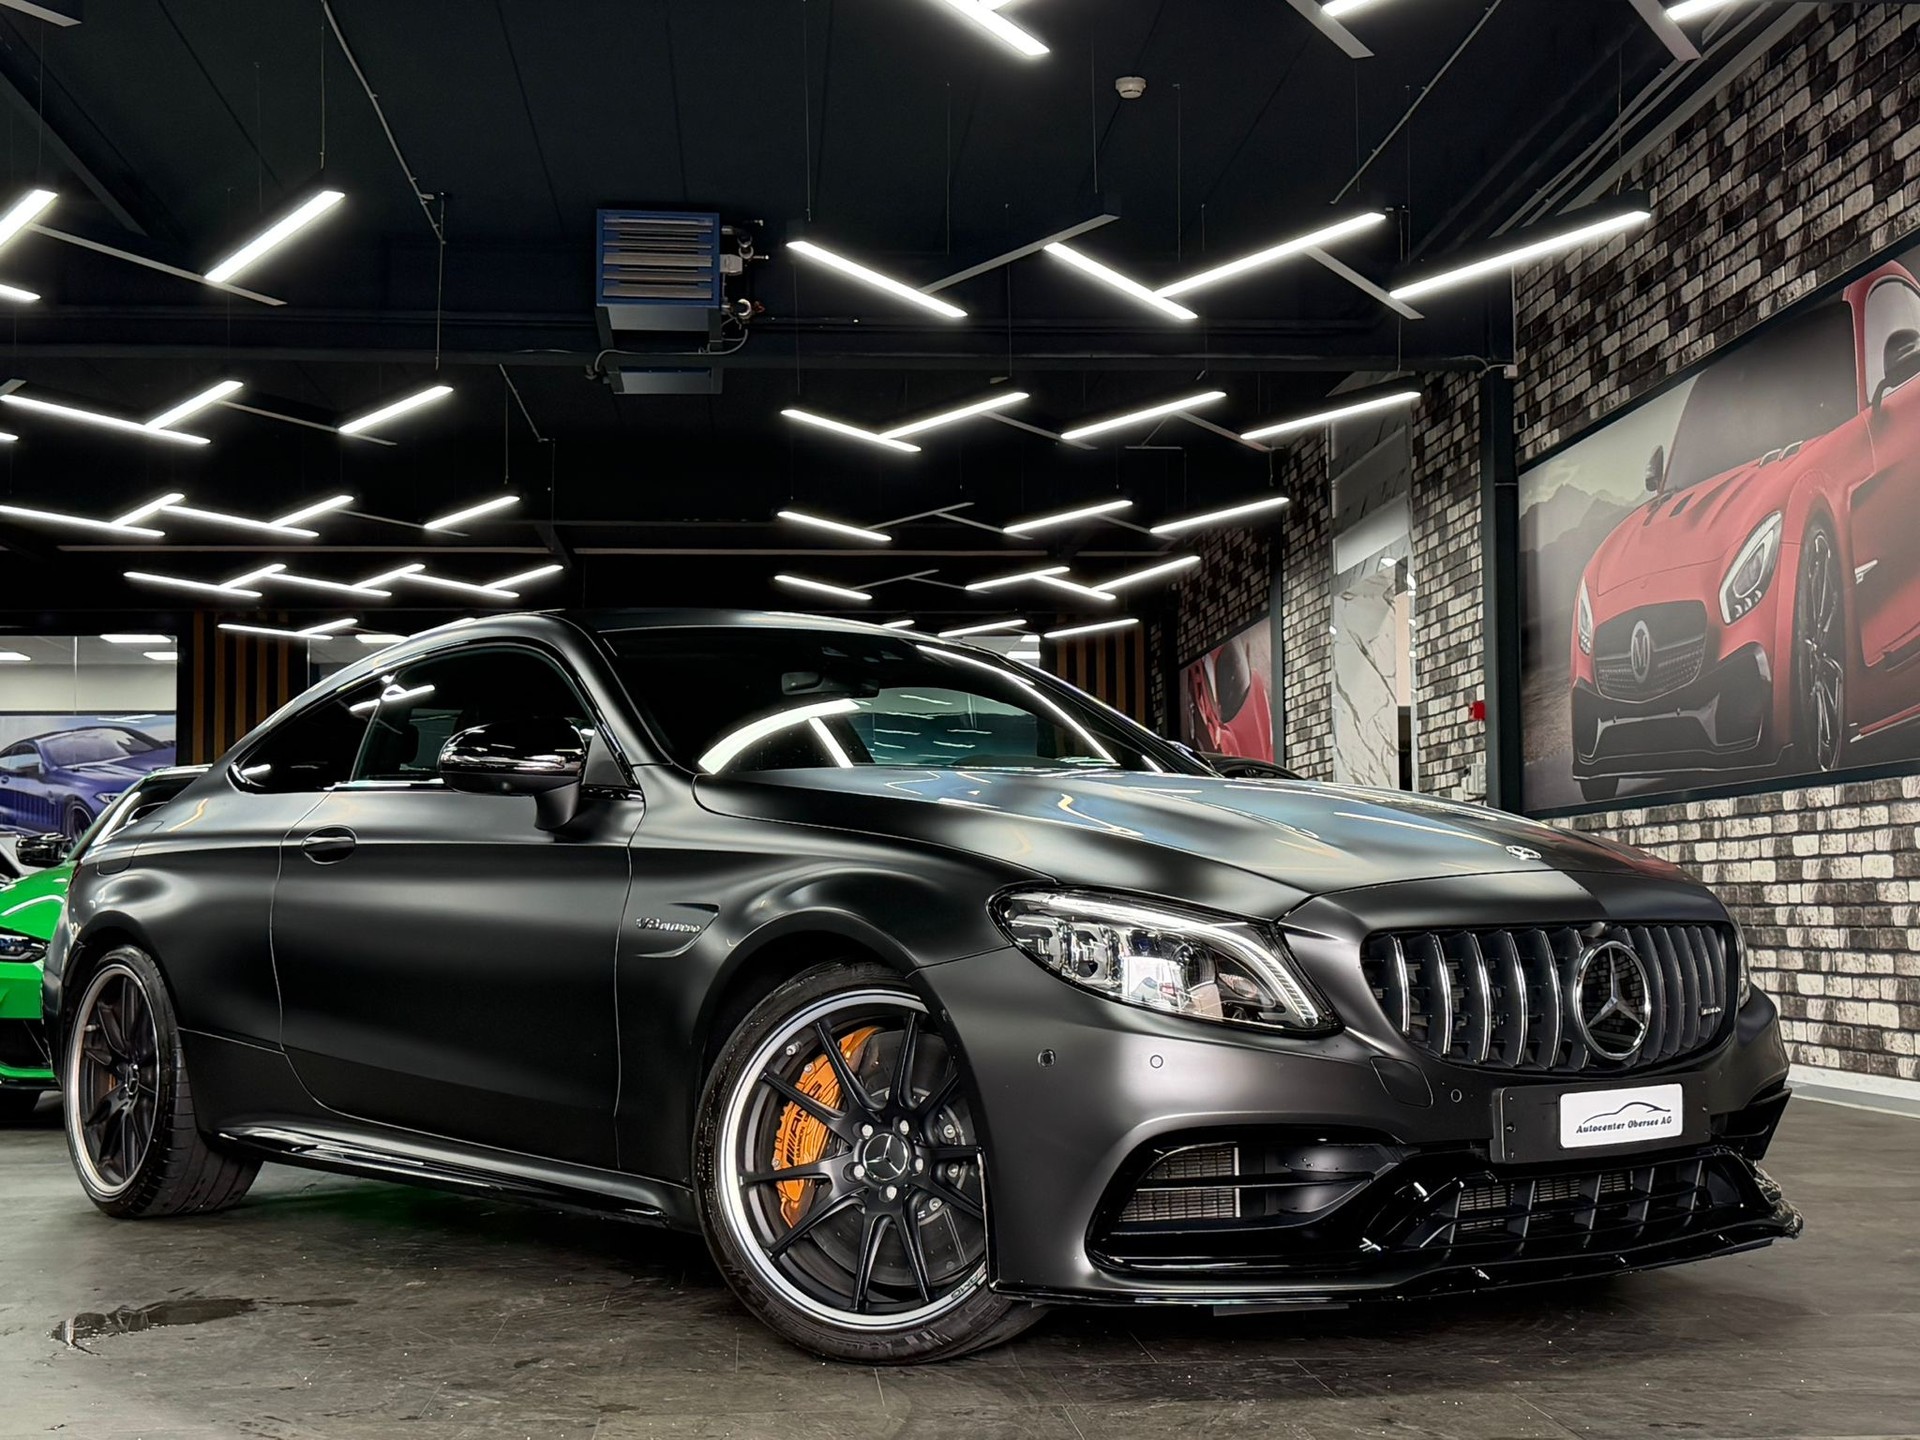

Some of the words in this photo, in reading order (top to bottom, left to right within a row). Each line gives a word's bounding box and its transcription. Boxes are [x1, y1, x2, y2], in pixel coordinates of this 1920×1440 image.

[1576, 1122, 1625, 1134] Autocenter
[1627, 1118, 1659, 1129] Obersee
[1660, 1115, 1672, 1125] AG
